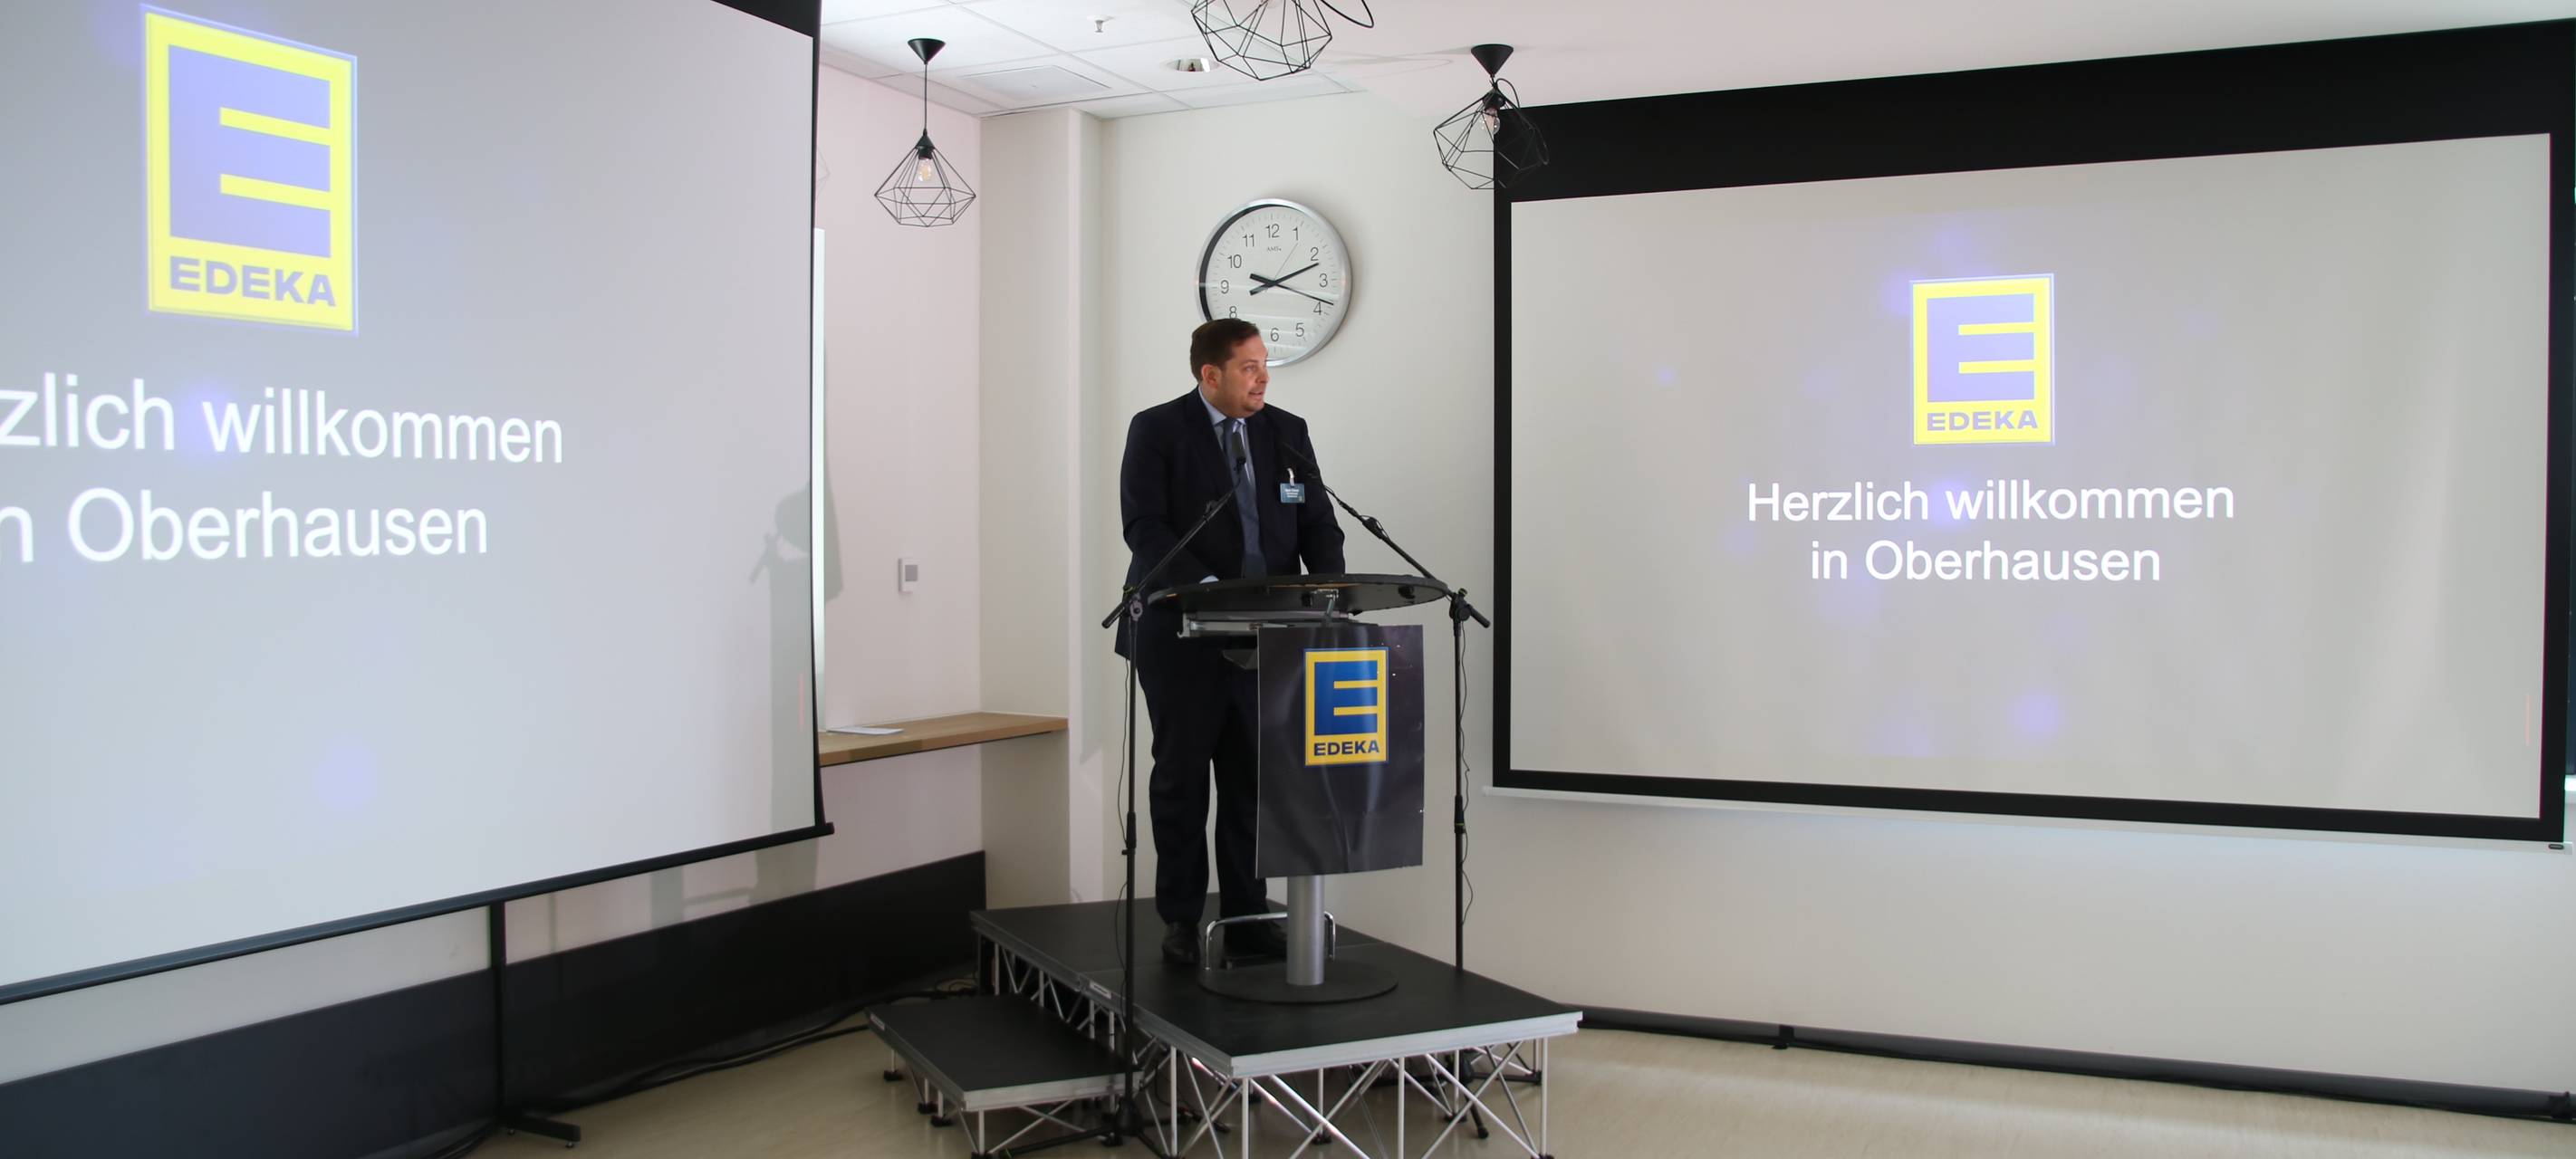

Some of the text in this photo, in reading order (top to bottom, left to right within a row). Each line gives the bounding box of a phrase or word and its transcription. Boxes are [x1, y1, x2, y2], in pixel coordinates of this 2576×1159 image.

[1265, 224, 1280, 238] 12
[1292, 227, 1299, 241] 1
[1243, 234, 1255, 247] 11
[1227, 254, 1242, 268] 10
[1310, 247, 1319, 261] 2
[169, 255, 336, 307] EDEKA
[1220, 280, 1229, 293] 9
[1319, 273, 1328, 287] 3
[1312, 301, 1322, 315] 4
[1270, 328, 1280, 341] 6
[1295, 323, 1304, 337] 5
[203, 387, 563, 463] willkommen
[1927, 410, 2039, 431] EDEKA
[1748, 479, 2235, 522] Herzlich willkommen
[68, 487, 487, 561] Oberhausen
[1812, 541, 2160, 580] in Oberhausen
[1313, 740, 1379, 756] EDEKA
